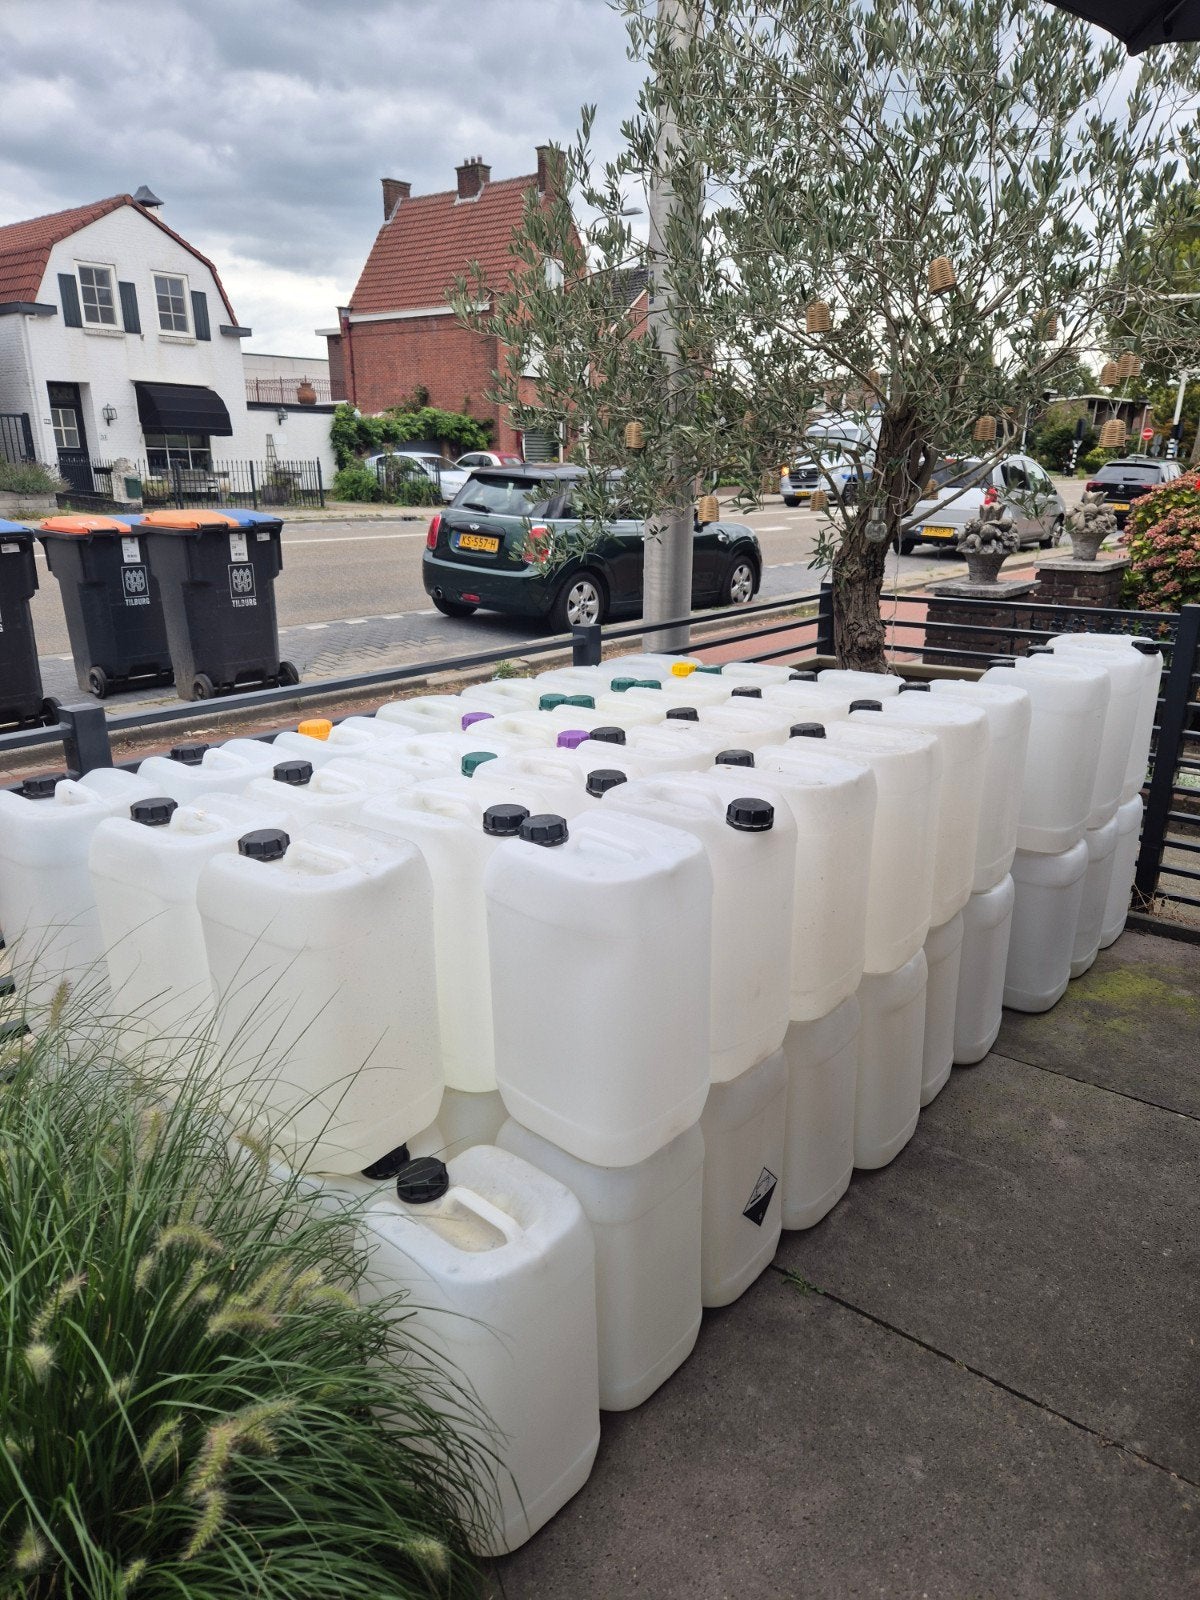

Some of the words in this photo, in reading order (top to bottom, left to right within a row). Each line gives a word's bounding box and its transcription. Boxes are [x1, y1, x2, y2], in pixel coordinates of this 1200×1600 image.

[461, 535, 497, 550] KS-557-H
[125, 597, 150, 606] TILBURG
[231, 598, 257, 608] TILBURG
